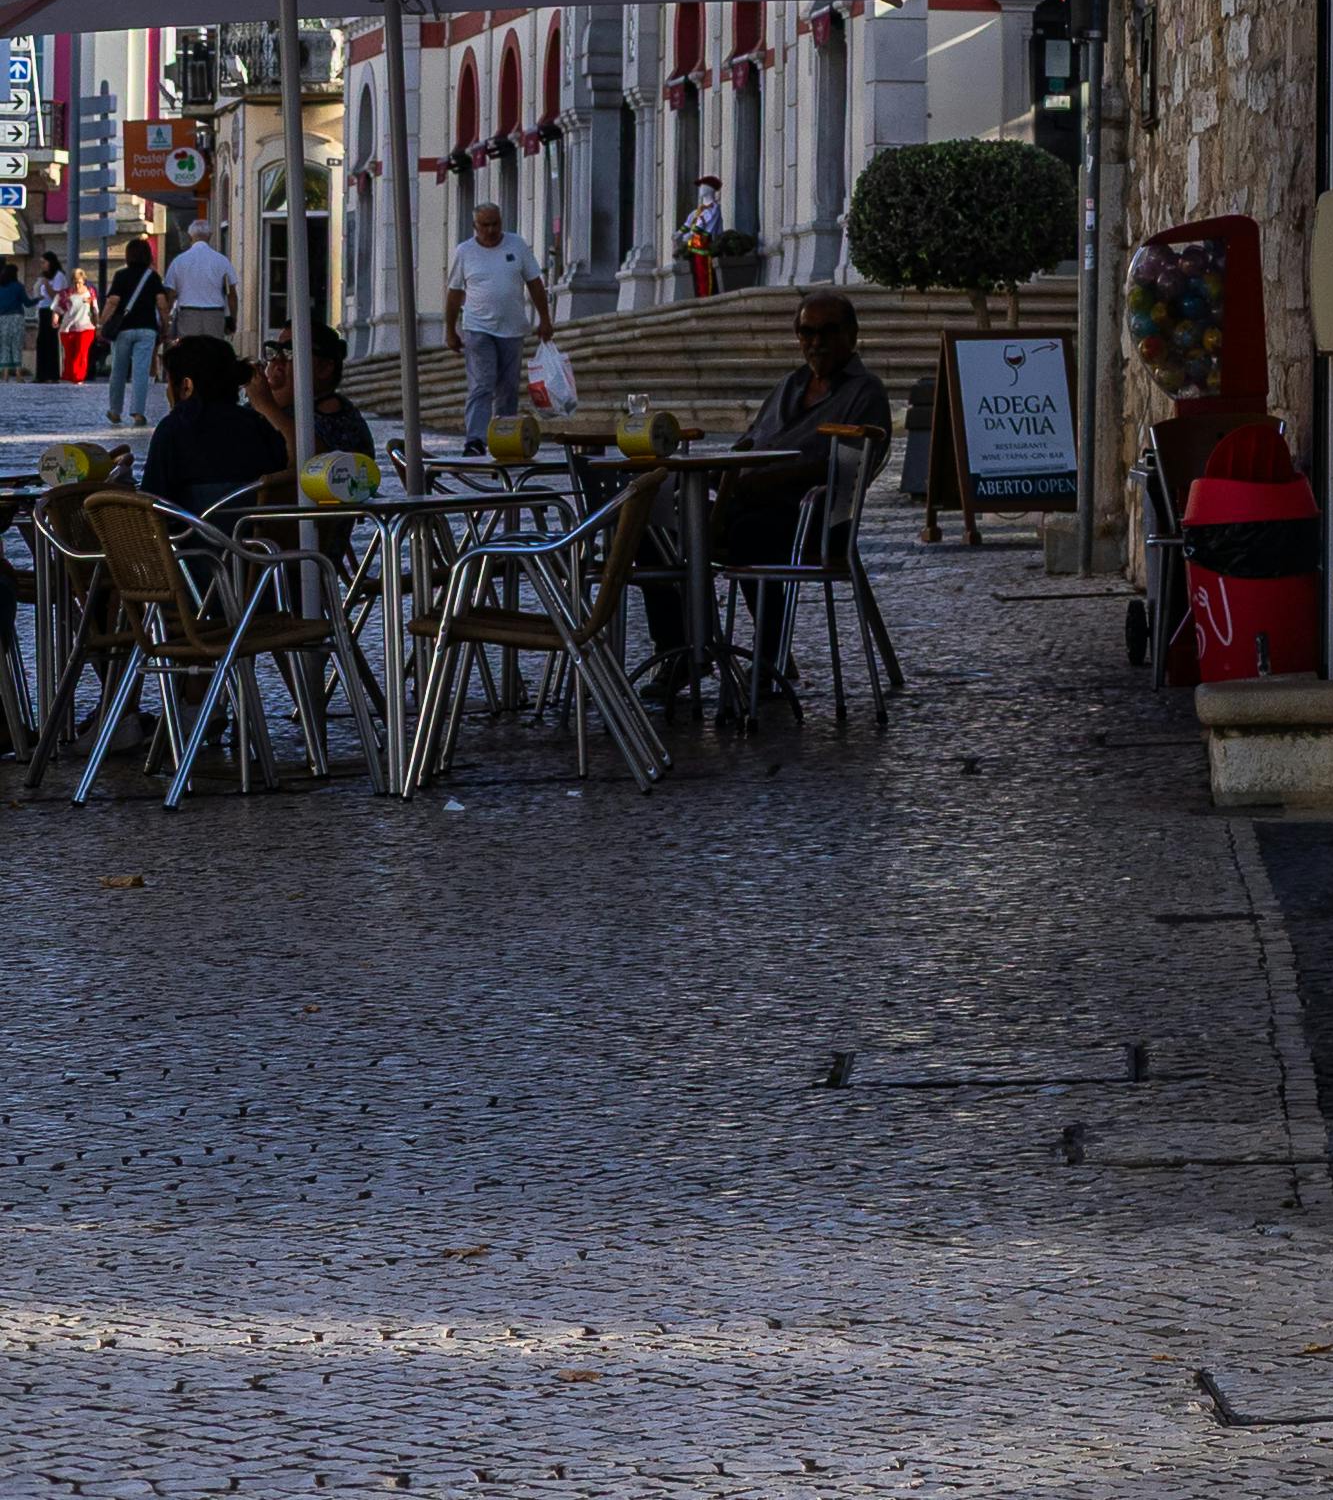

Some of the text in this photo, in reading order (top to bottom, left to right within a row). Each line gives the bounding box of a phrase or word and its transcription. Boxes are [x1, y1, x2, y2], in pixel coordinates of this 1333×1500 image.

[978, 395, 1057, 415] ADEGA
[984, 416, 1056, 436] DA VILA
[995, 443, 1048, 451] RESTAURANTE
[977, 478, 1033, 496] ABERTO
